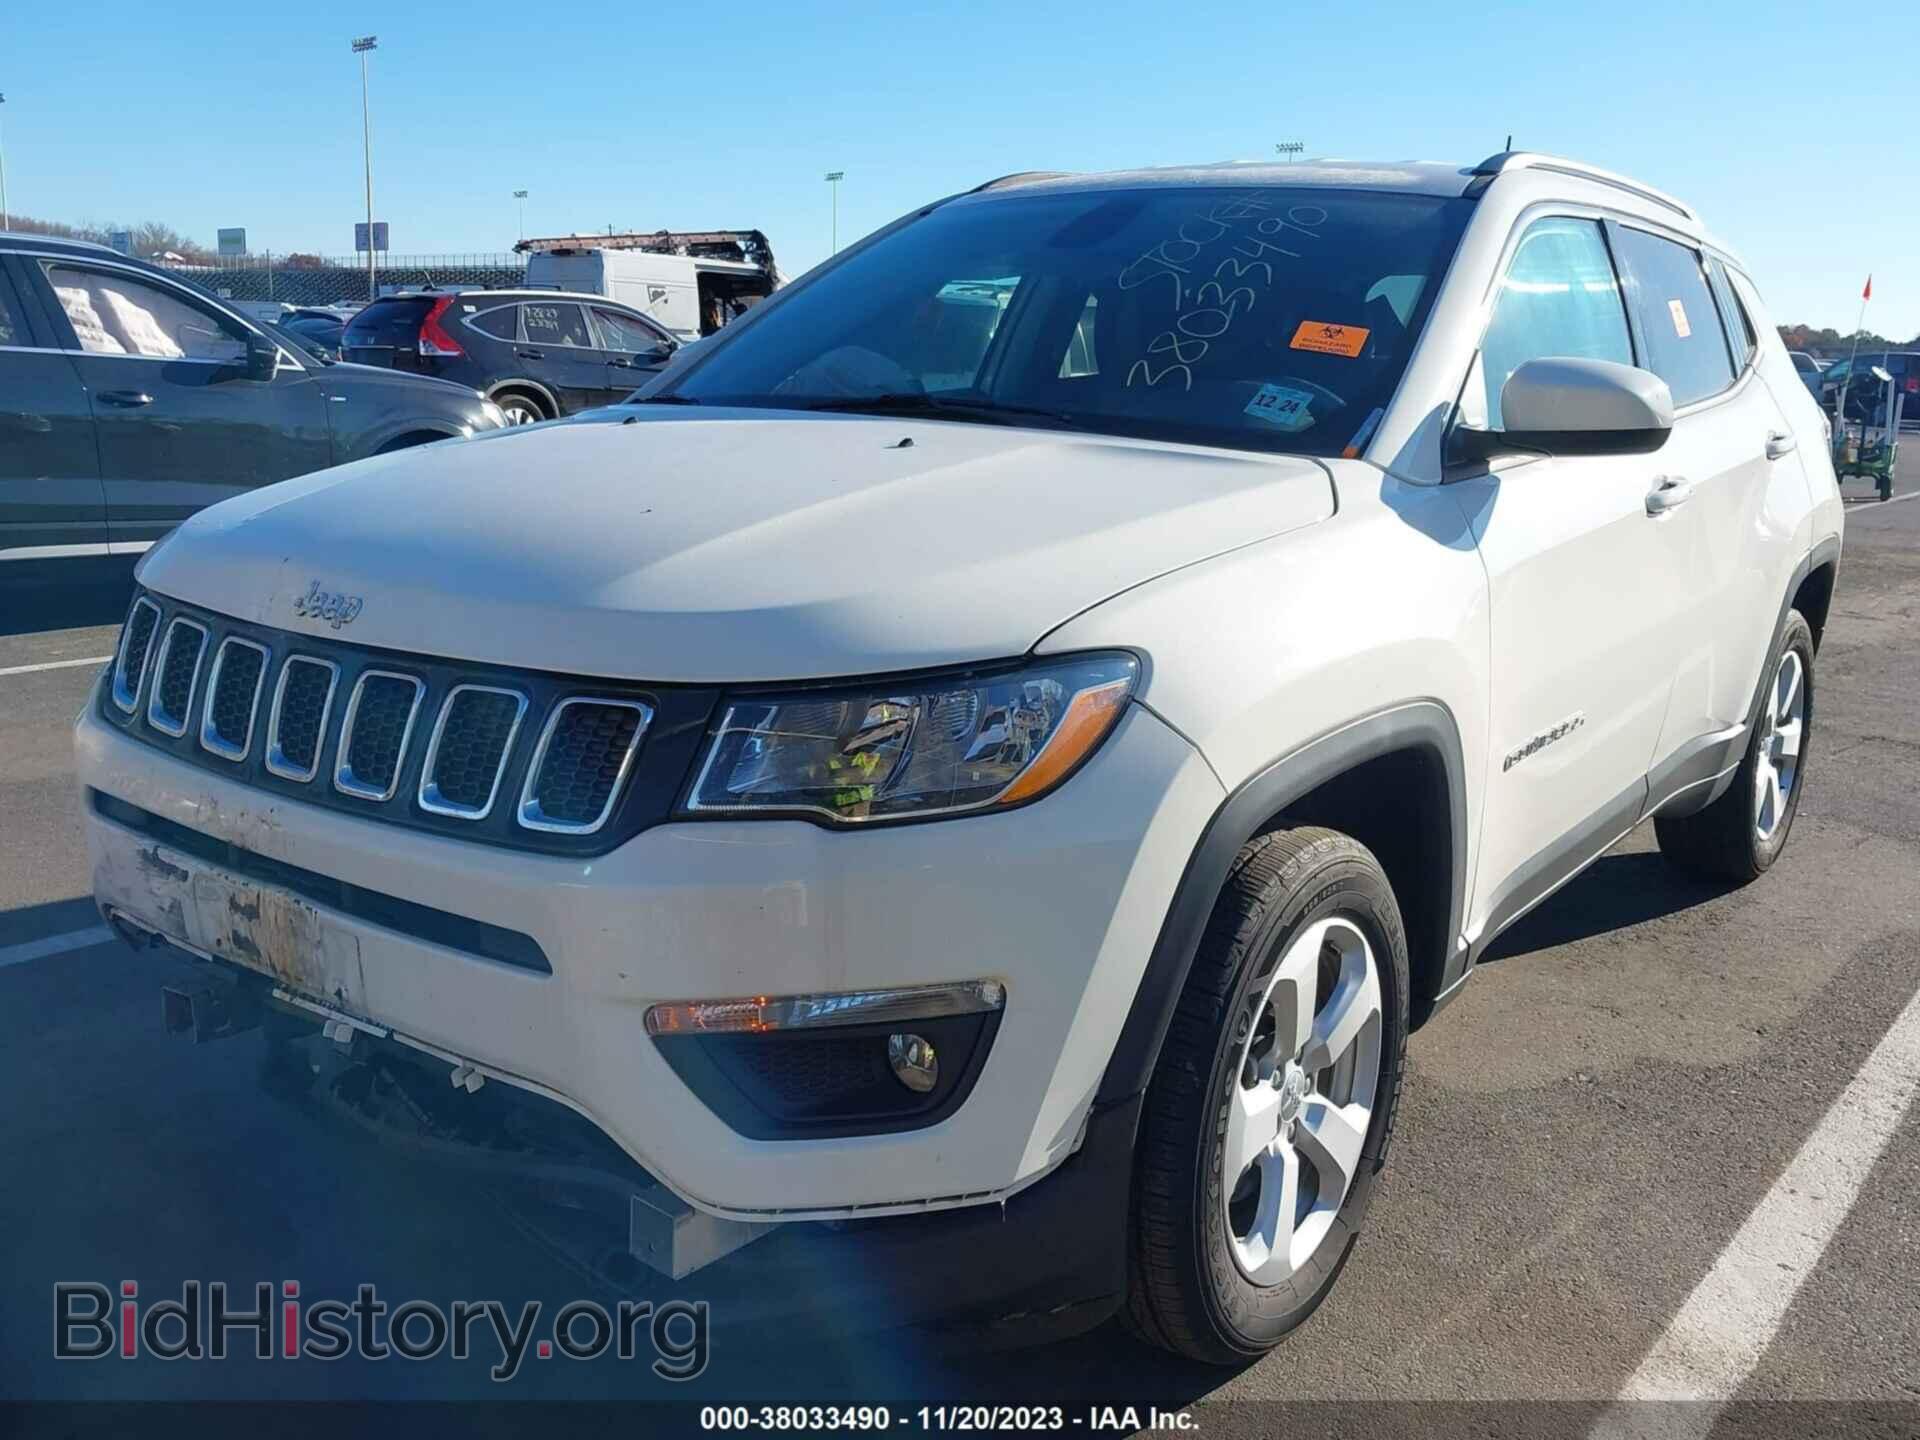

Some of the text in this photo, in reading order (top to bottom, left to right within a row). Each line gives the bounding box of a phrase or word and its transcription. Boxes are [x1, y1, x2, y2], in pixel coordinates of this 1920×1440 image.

[1127, 206, 1328, 392] 38033490
[1255, 394, 1300, 414] 12 24
[294, 579, 363, 630] Jeep
